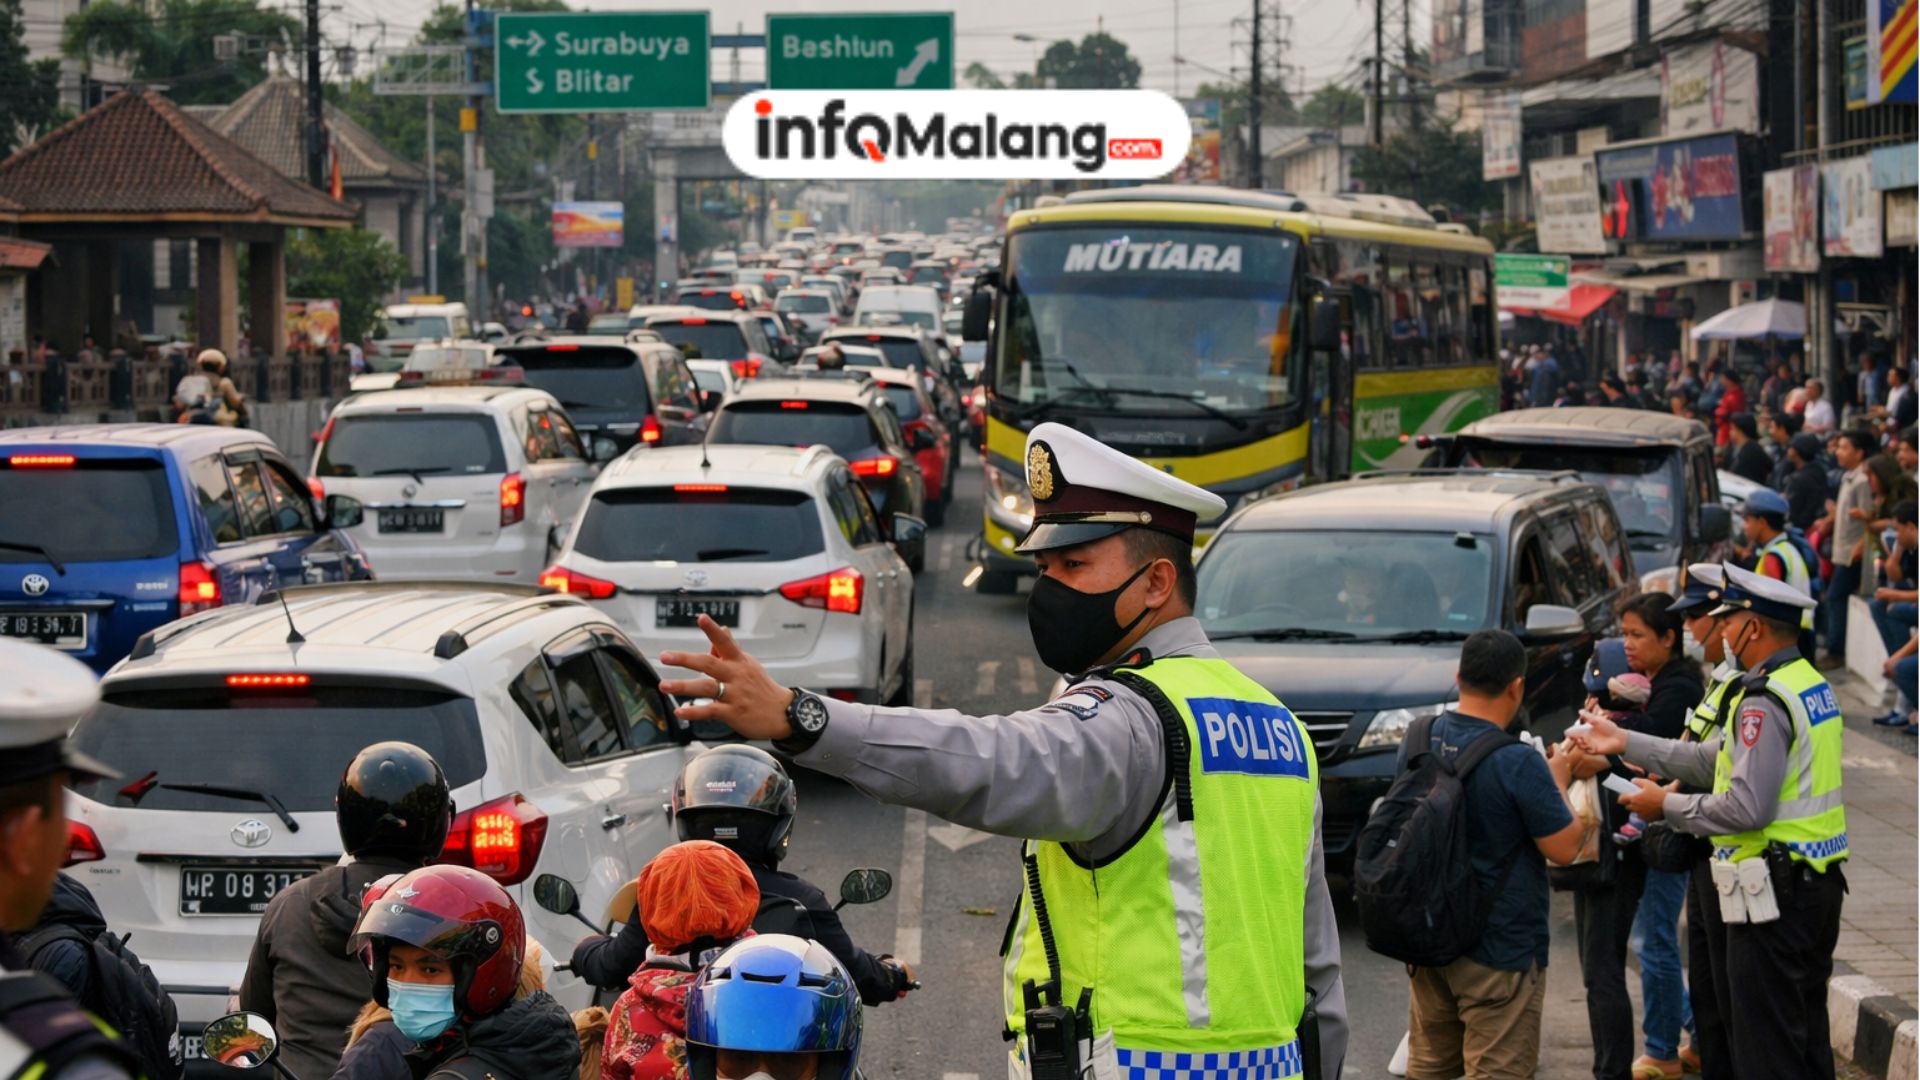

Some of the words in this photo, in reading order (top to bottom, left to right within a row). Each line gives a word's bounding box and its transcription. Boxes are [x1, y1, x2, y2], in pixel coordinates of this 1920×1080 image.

[555, 31, 690, 61] Surabuya
[556, 68, 634, 93] Blitar
[1063, 243, 1243, 273] MUTIARA
[1202, 712, 1303, 763] POLISI
[225, 873, 254, 898] 08
